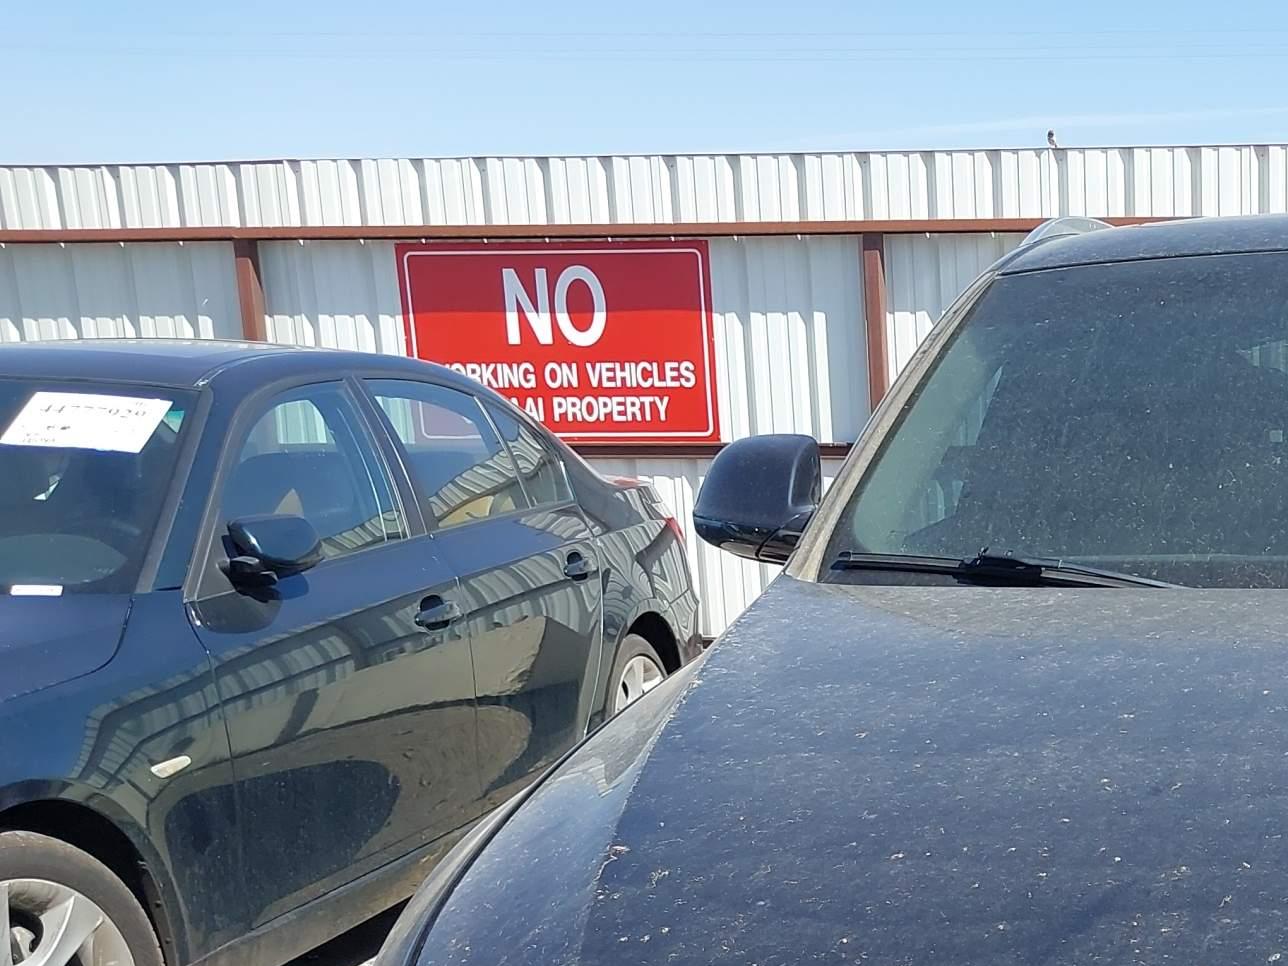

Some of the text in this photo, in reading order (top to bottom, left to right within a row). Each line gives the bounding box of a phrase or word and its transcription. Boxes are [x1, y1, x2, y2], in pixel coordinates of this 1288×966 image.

[502, 264, 607, 347] NO
[444, 361, 696, 389] RKING ON VEHICLES
[552, 395, 670, 423] PROPERTY
